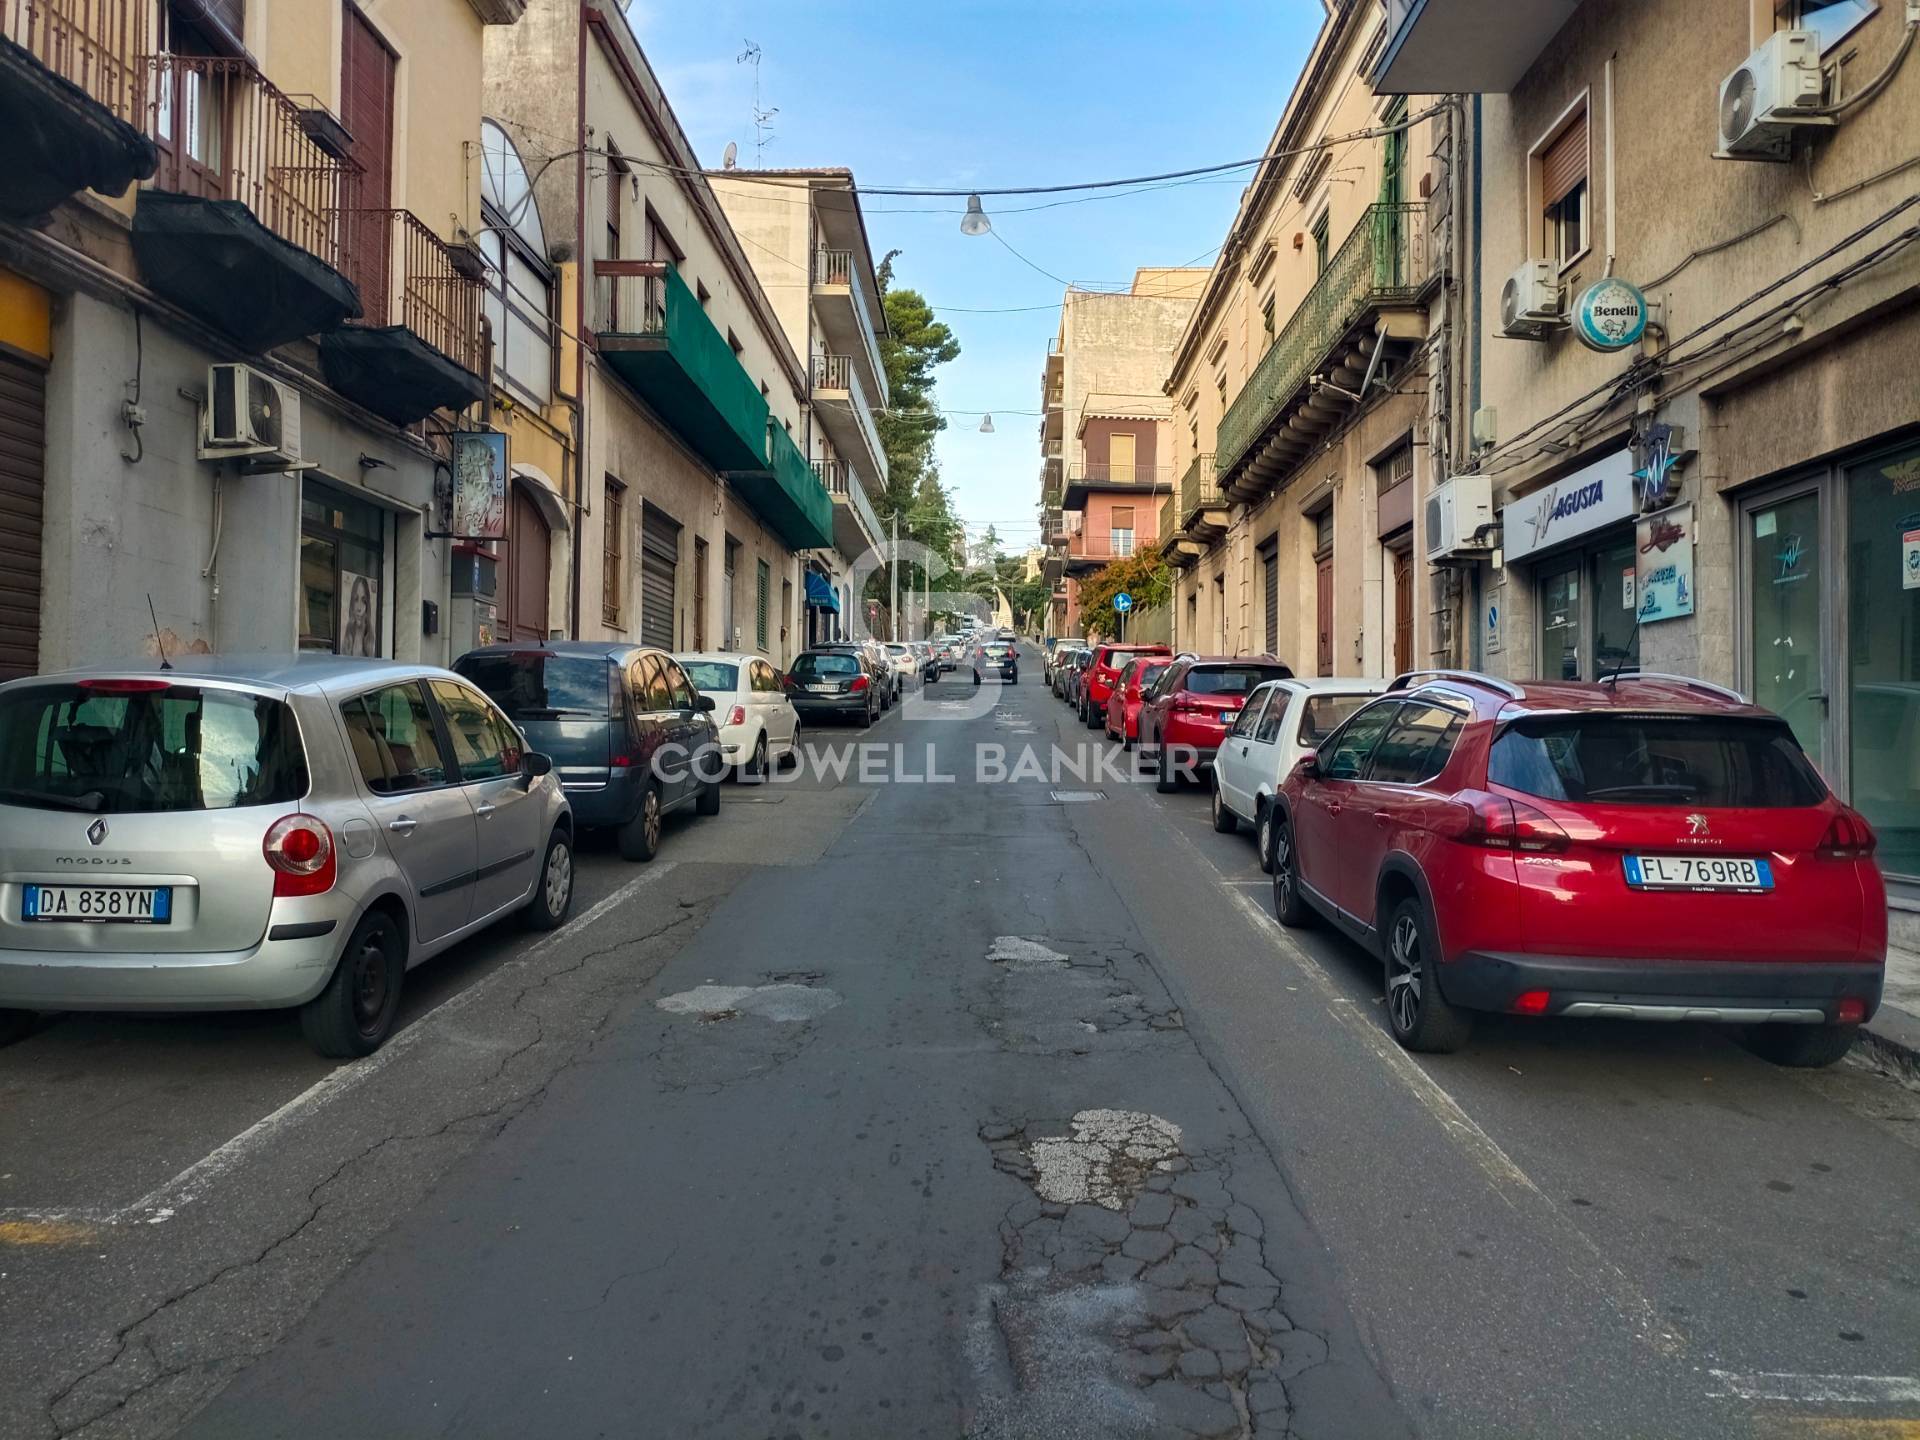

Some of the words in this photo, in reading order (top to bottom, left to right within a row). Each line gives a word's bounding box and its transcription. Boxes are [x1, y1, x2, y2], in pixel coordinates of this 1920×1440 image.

[1594, 305, 1638, 317] Benelli
[1553, 479, 1604, 520] AGUSTA
[1642, 859, 1673, 881] FL
[1679, 861, 1757, 884] 769RB
[41, 889, 68, 913] DA
[79, 890, 152, 915] 838YN
